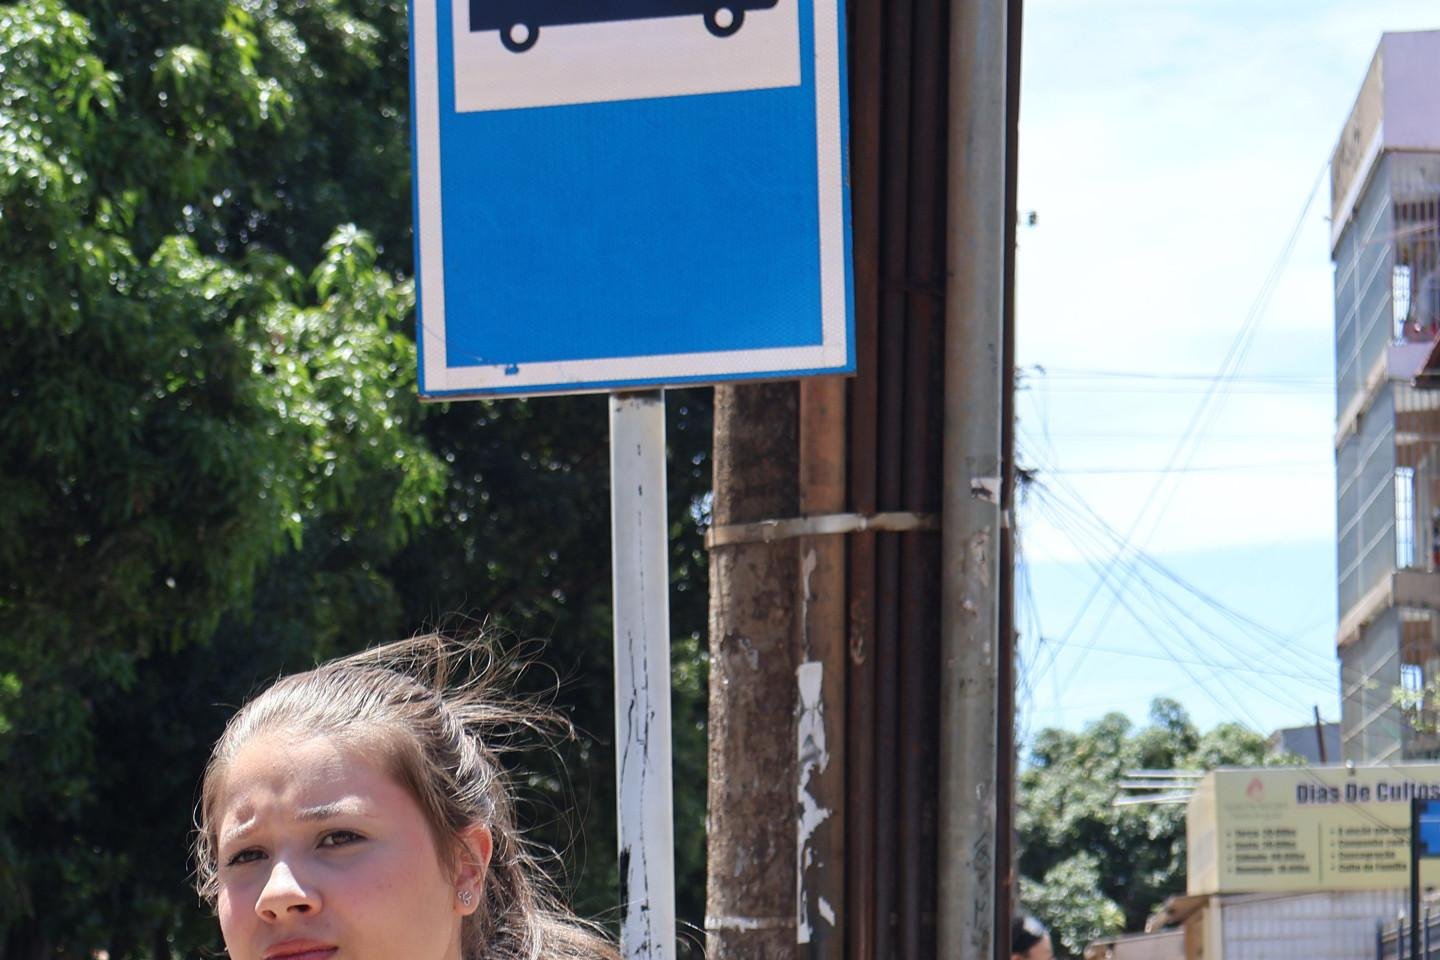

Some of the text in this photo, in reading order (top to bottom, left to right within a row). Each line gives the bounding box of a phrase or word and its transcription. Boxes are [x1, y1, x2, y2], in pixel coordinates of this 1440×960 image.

[1297, 779, 1440, 804] Dias De Cultos
